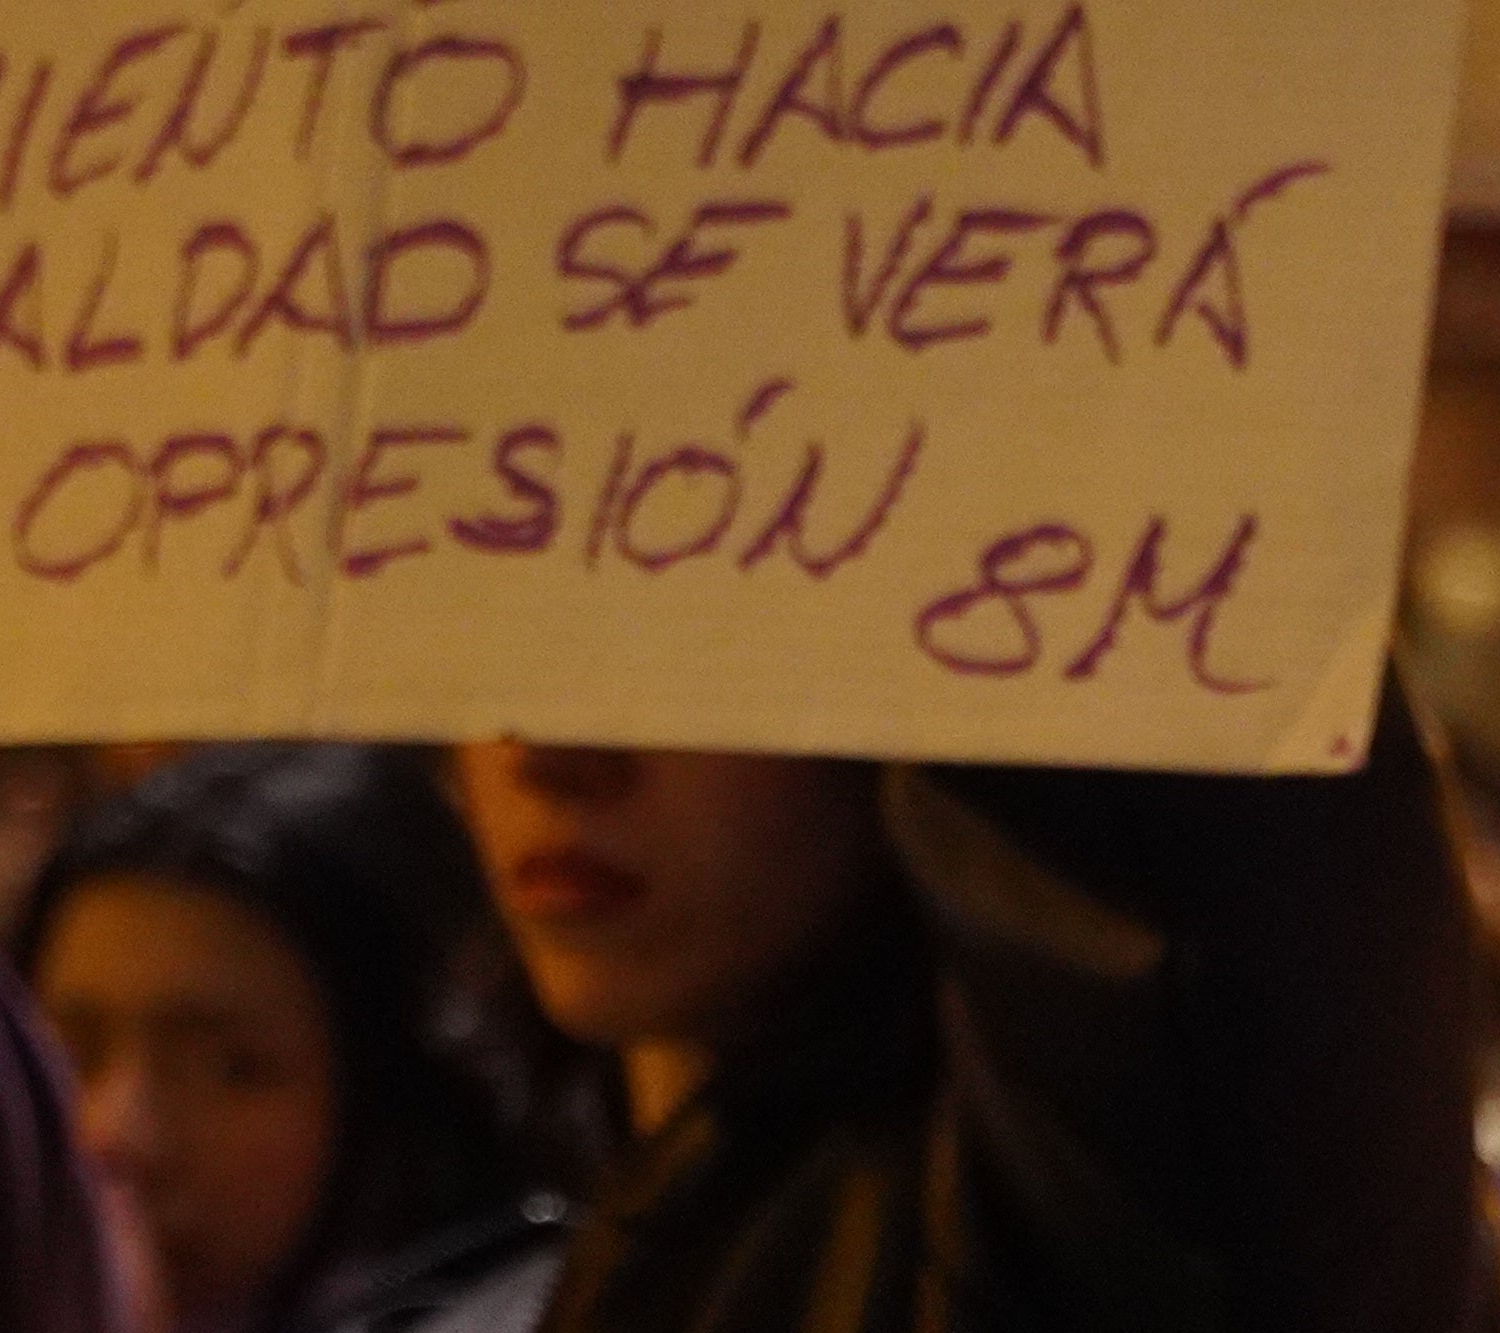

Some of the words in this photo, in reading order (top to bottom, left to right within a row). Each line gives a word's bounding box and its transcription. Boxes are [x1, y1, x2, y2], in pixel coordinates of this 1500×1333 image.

[608, 6, 1104, 168] HACIA
[552, 202, 794, 336] SE
[844, 162, 1332, 368] VERÁ
[12, 378, 924, 590] OPRESIÓN
[910, 515, 1280, 692] 8M
